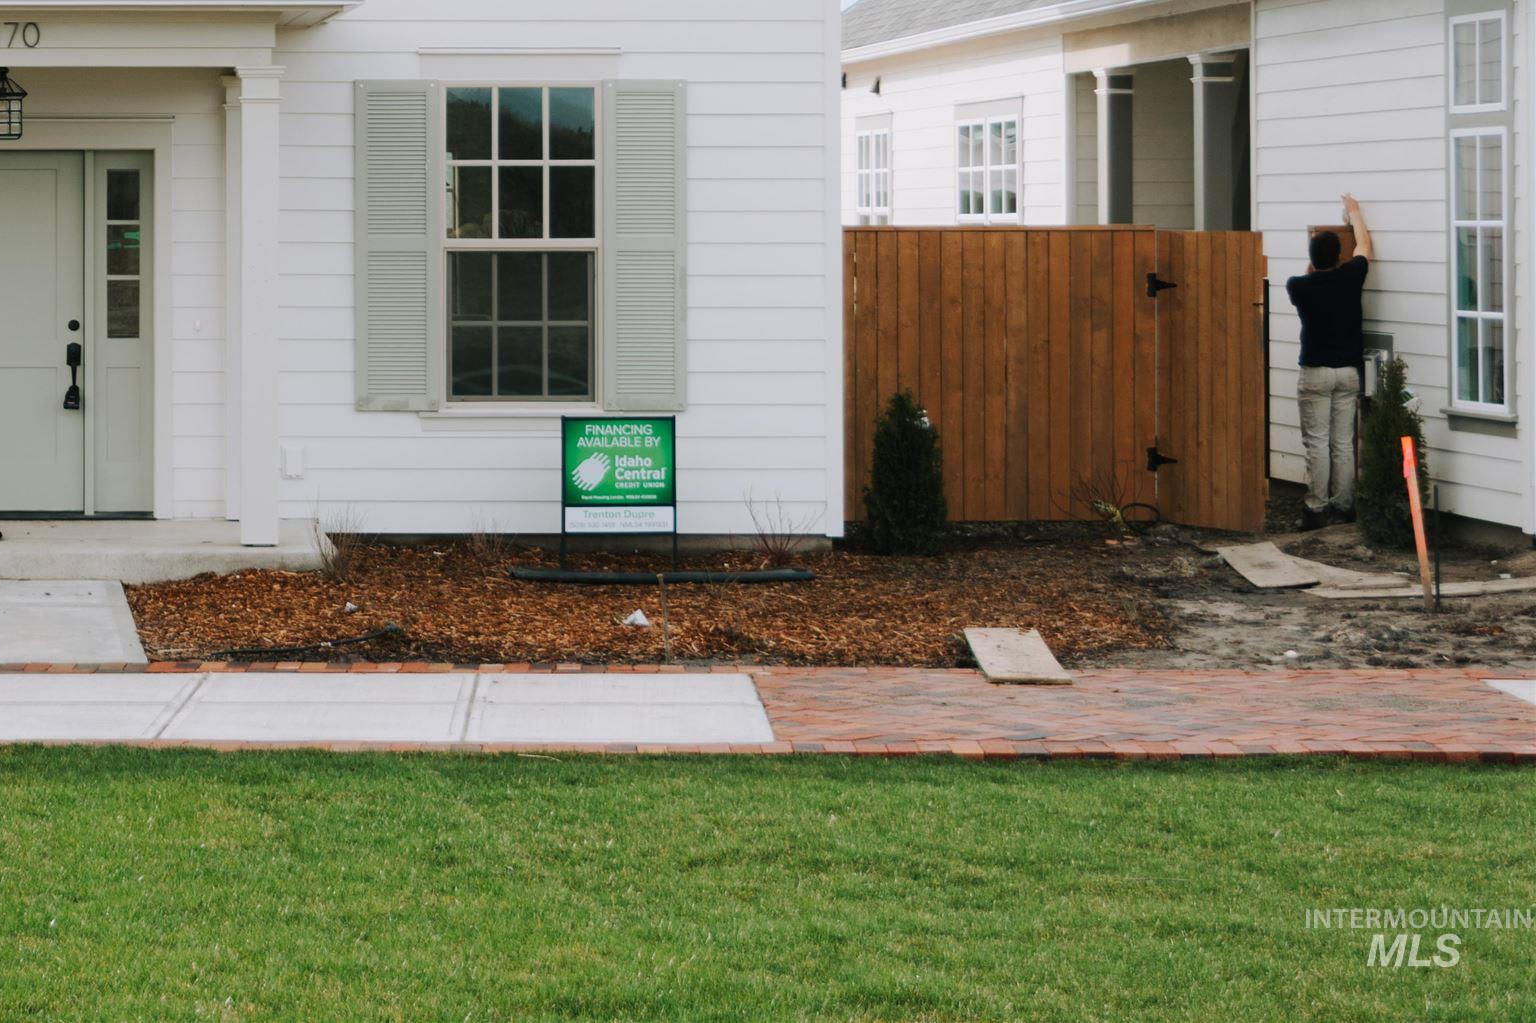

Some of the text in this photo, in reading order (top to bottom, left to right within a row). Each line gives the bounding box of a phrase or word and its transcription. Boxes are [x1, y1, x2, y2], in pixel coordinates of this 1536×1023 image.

[585, 424, 653, 436] FINANCING
[577, 436, 661, 448] AVAILABLE BY
[615, 455, 652, 467] Idaho
[615, 467, 666, 480] Central
[583, 510, 621, 519] Trenton
